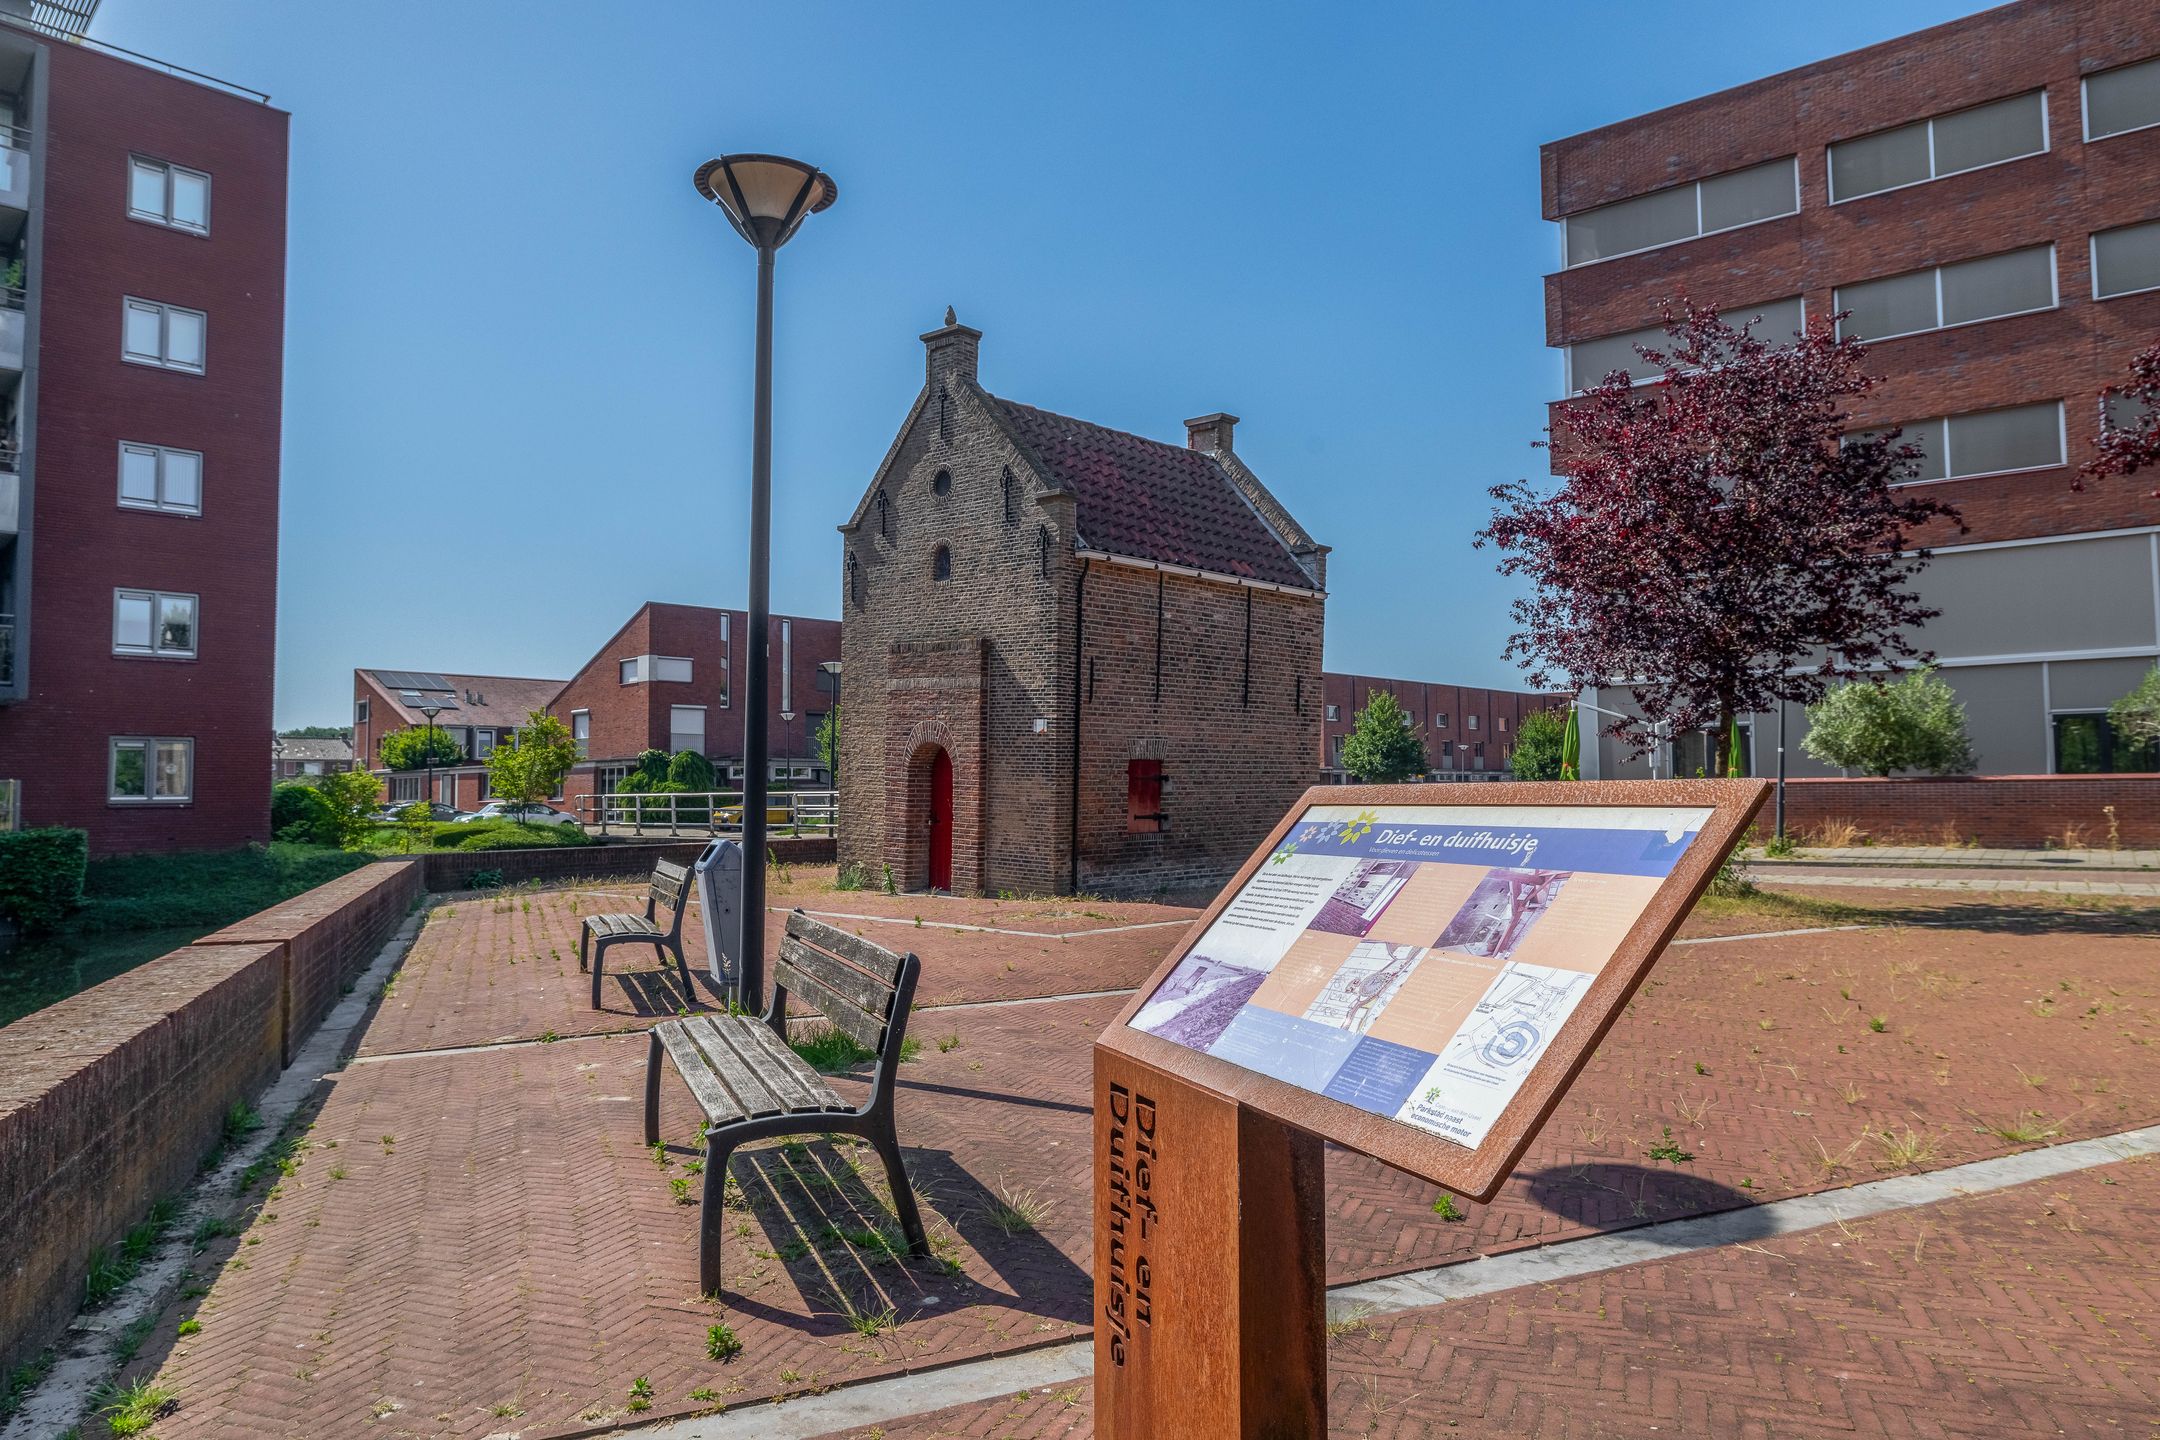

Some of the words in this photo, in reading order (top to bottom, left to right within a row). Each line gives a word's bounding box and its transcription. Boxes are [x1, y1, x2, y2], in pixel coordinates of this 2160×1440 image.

[1375, 829, 1418, 845] Dief-
[1419, 834, 1443, 847] en
[1443, 830, 1539, 855] duifhuisje
[1411, 1113, 1451, 1131] economische
[1450, 1126, 1472, 1138] motor
[1416, 1103, 1445, 1119] Parkstad
[1444, 1114, 1463, 1125] naast
[1135, 1092, 1158, 1242] Dief-
[1104, 1081, 1132, 1368] Duifhuisje
[1135, 1255, 1153, 1328] en
